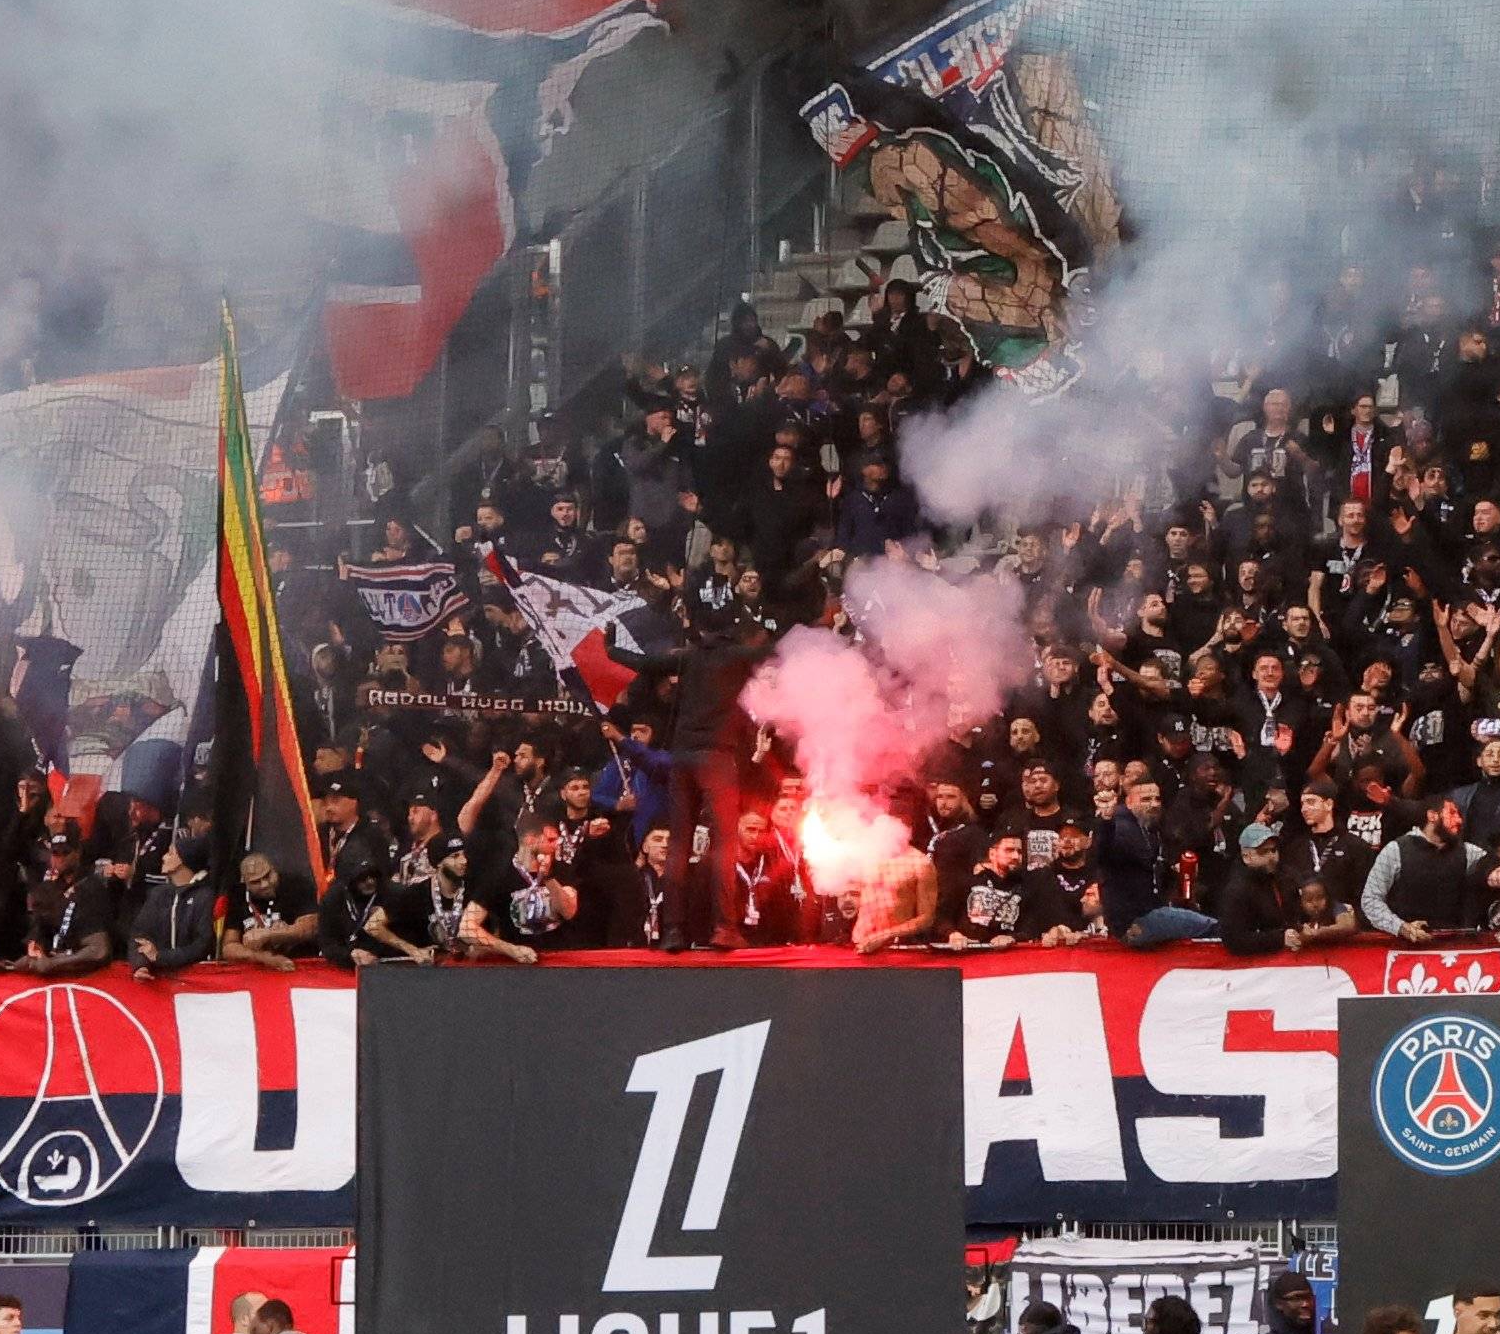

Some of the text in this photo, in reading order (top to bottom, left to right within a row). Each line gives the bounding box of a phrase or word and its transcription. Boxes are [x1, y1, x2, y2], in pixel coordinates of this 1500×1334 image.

[1400, 1024, 1496, 1062] PARIS
[1402, 1126, 1497, 1157] SAINT GERMAIN
